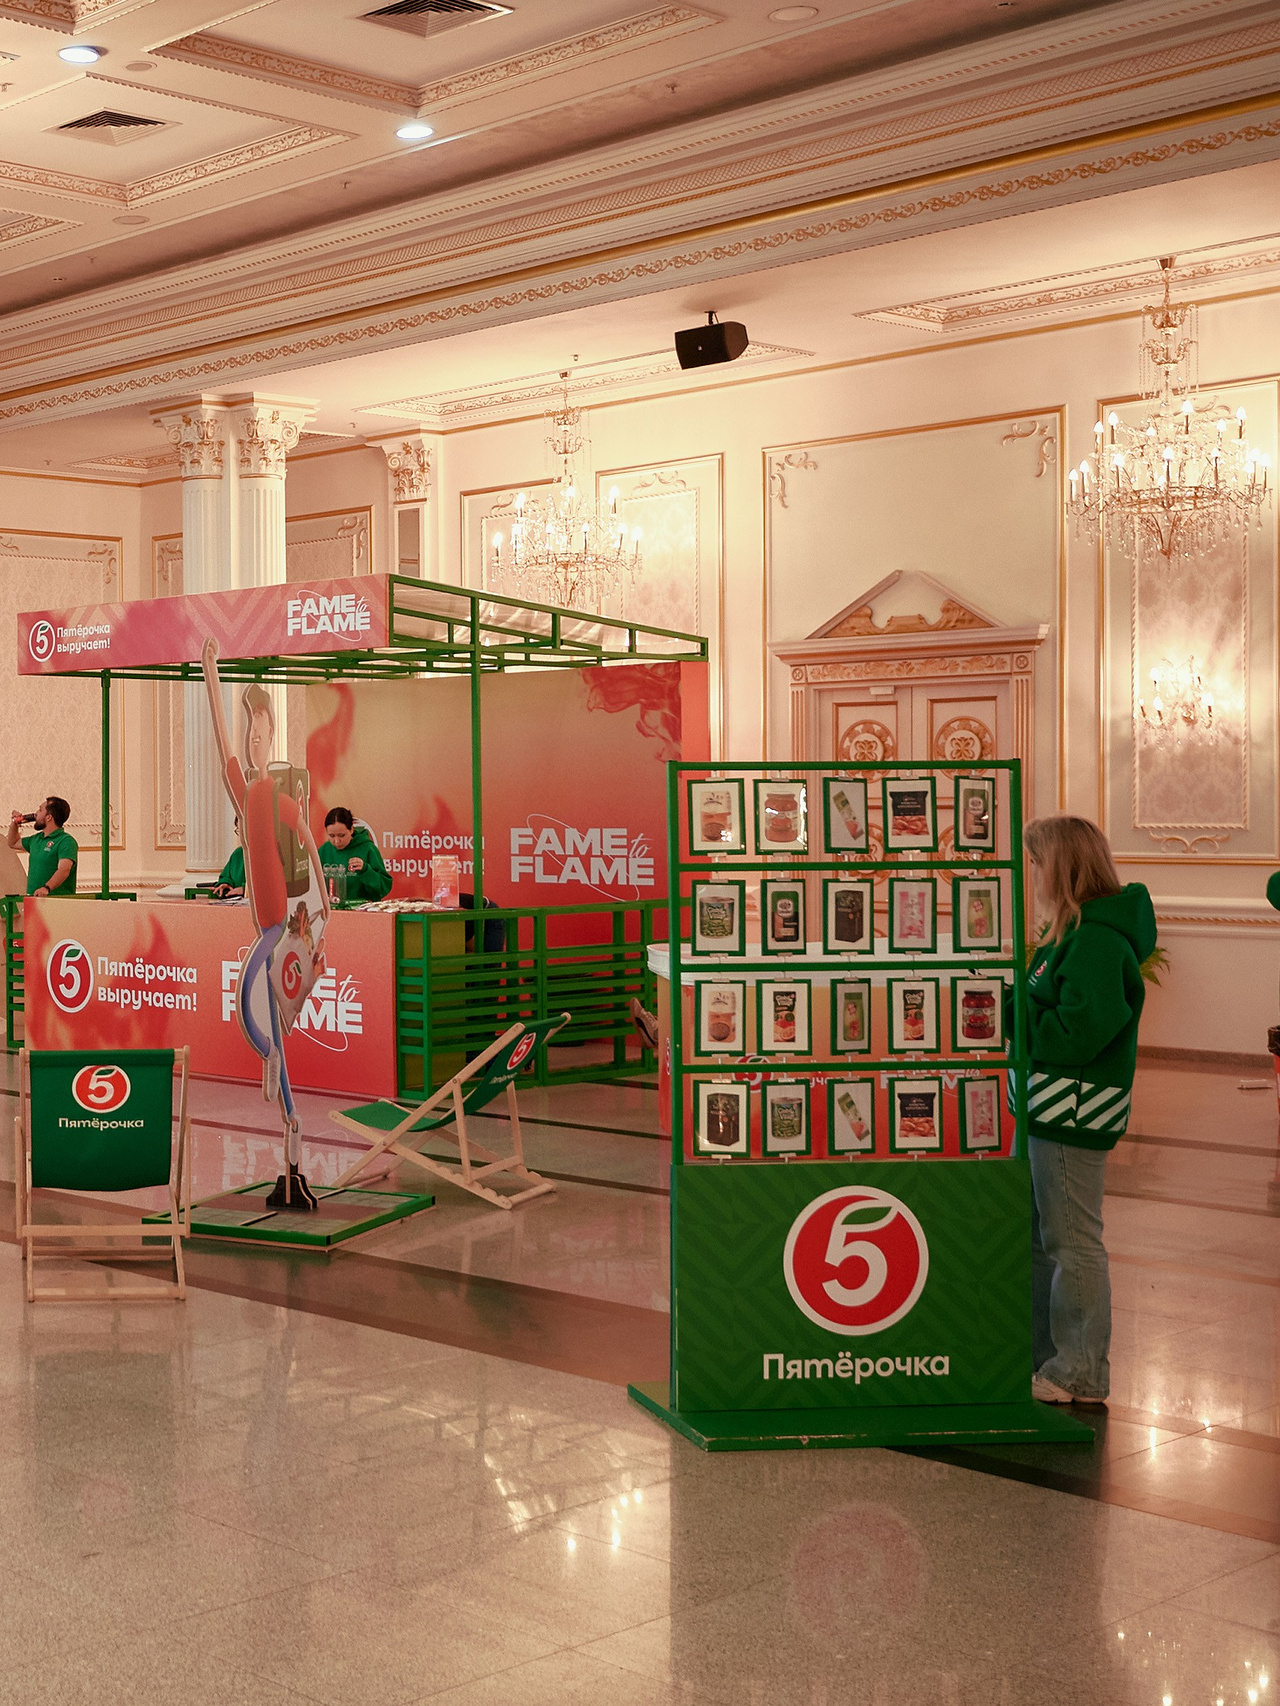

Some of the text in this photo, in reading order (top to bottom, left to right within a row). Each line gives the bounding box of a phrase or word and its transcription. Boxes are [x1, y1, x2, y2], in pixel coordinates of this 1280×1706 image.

[287, 593, 368, 618] FAME to
[56, 624, 111, 638] Пятёрочка
[287, 612, 371, 636] FLAME
[56, 638, 111, 654] выручает!
[382, 830, 485, 853] Пятёрочк
[510, 827, 653, 858] FAME to
[510, 855, 655, 886] FLAME
[97, 956, 198, 985] Пятёрочка
[221, 960, 364, 1003] FE to
[97, 986, 198, 1012] выручает!
[221, 991, 364, 1035] FME
[58, 1117, 144, 1131] Пятёрочка
[763, 1351, 950, 1385] Пятёрочка
